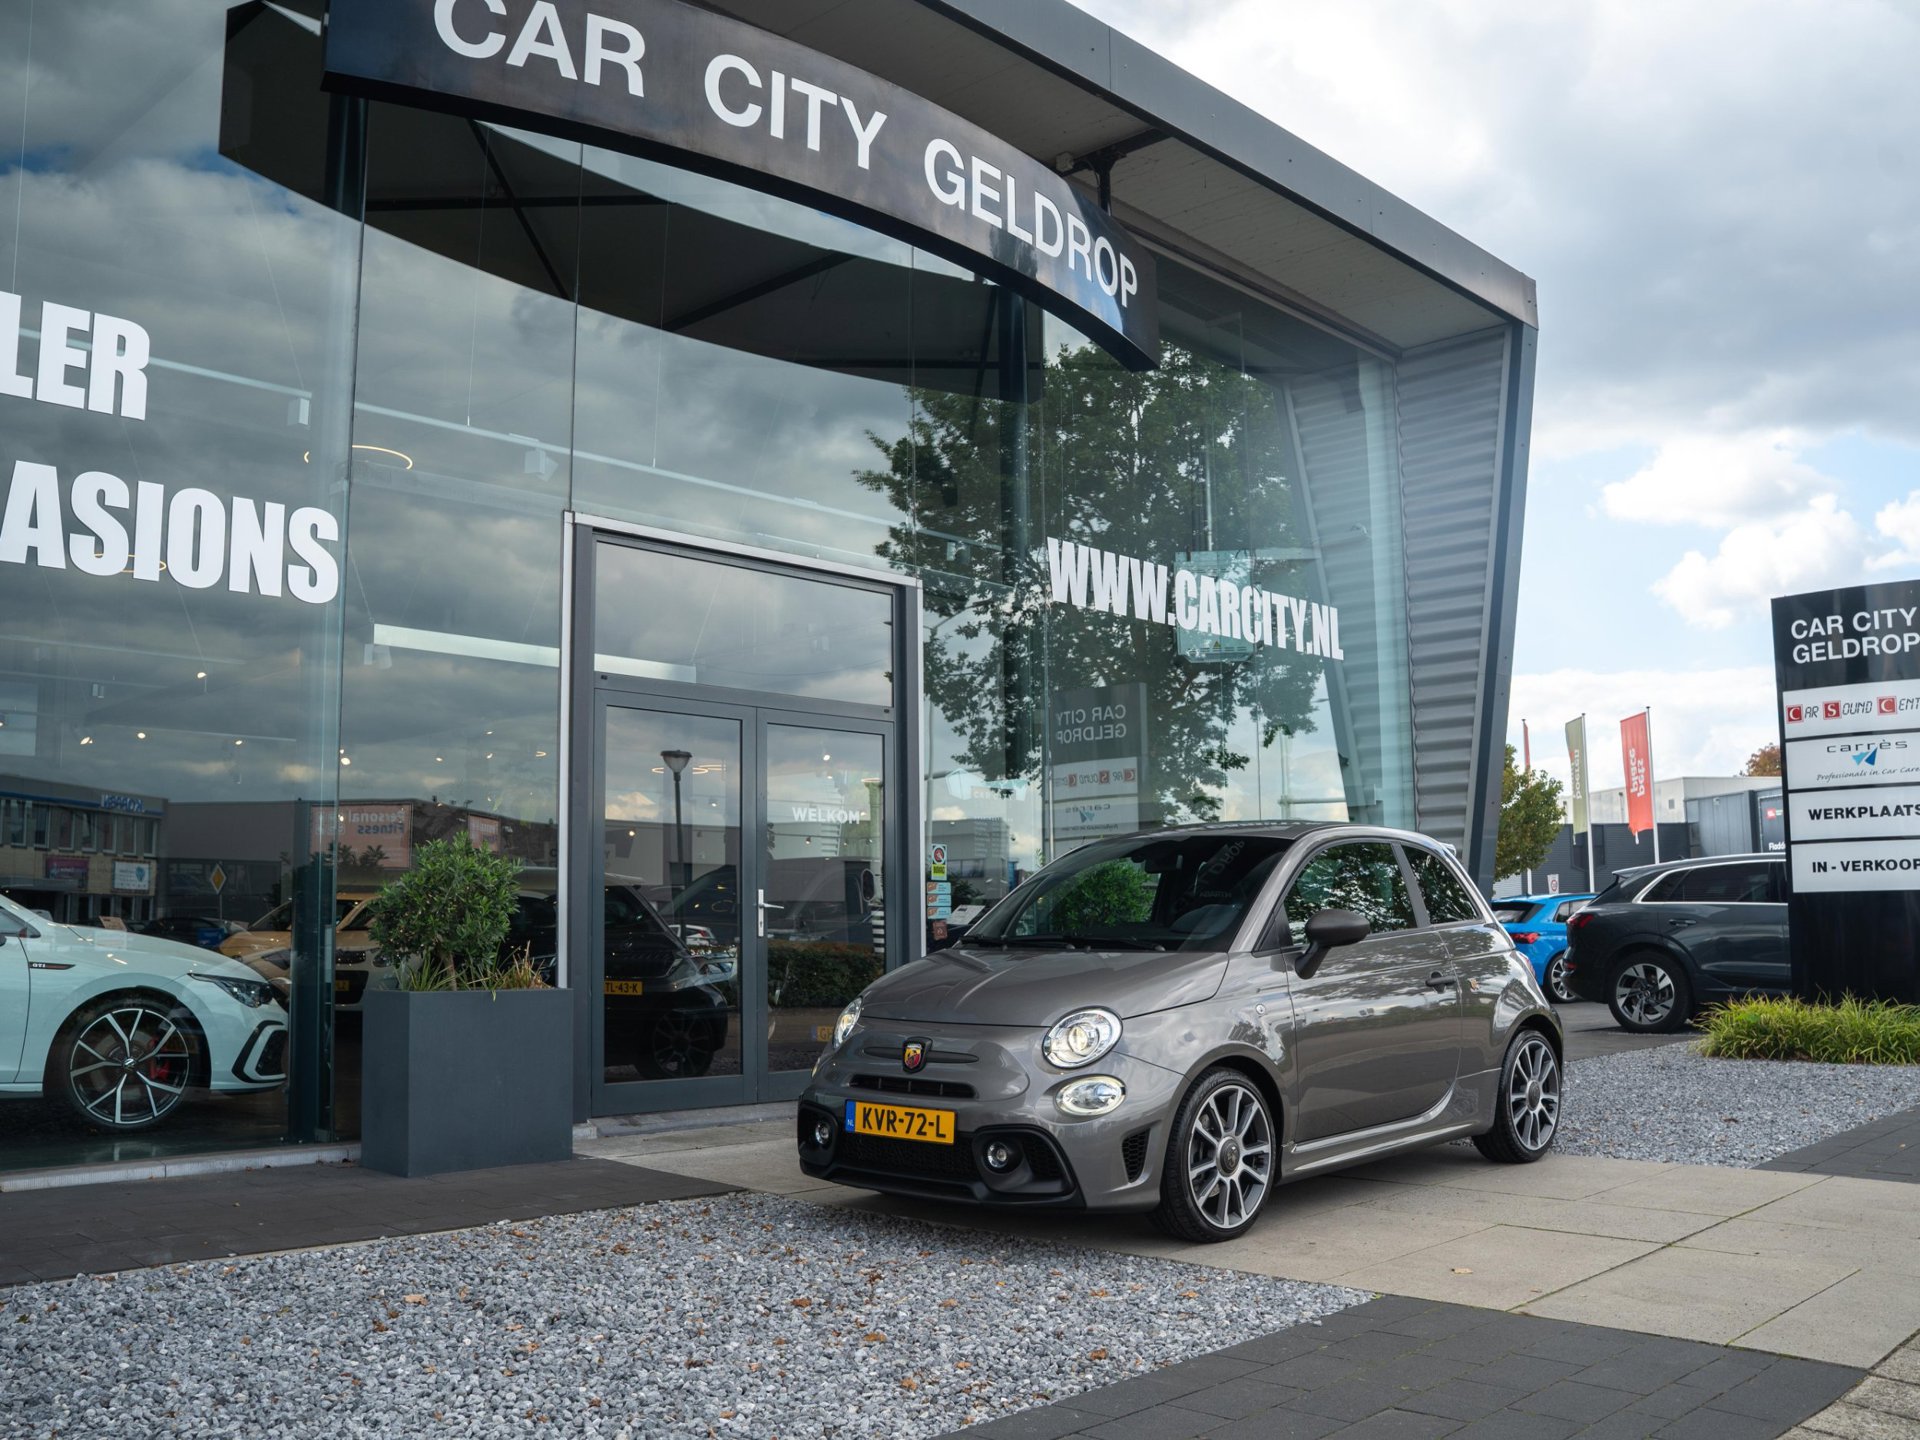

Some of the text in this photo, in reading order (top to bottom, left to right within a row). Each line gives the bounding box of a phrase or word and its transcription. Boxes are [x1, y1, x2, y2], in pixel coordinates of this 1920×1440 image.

[433, 0, 1139, 309] CAR CITY GELDROP
[0, 460, 339, 604] ASIONS
[1047, 536, 1344, 661] WWW.CARCITY.NL
[1791, 606, 1917, 639] CAR CITY
[1792, 632, 1920, 664] GELDROP
[1787, 705, 1819, 721] CAR
[1825, 700, 1873, 718] SOUND
[1826, 739, 1908, 753] carrès
[1869, 768, 1879, 776] in
[791, 806, 861, 825] WELKOM
[1812, 861, 1828, 873] IN
[861, 1106, 947, 1139] KVR-72-L
